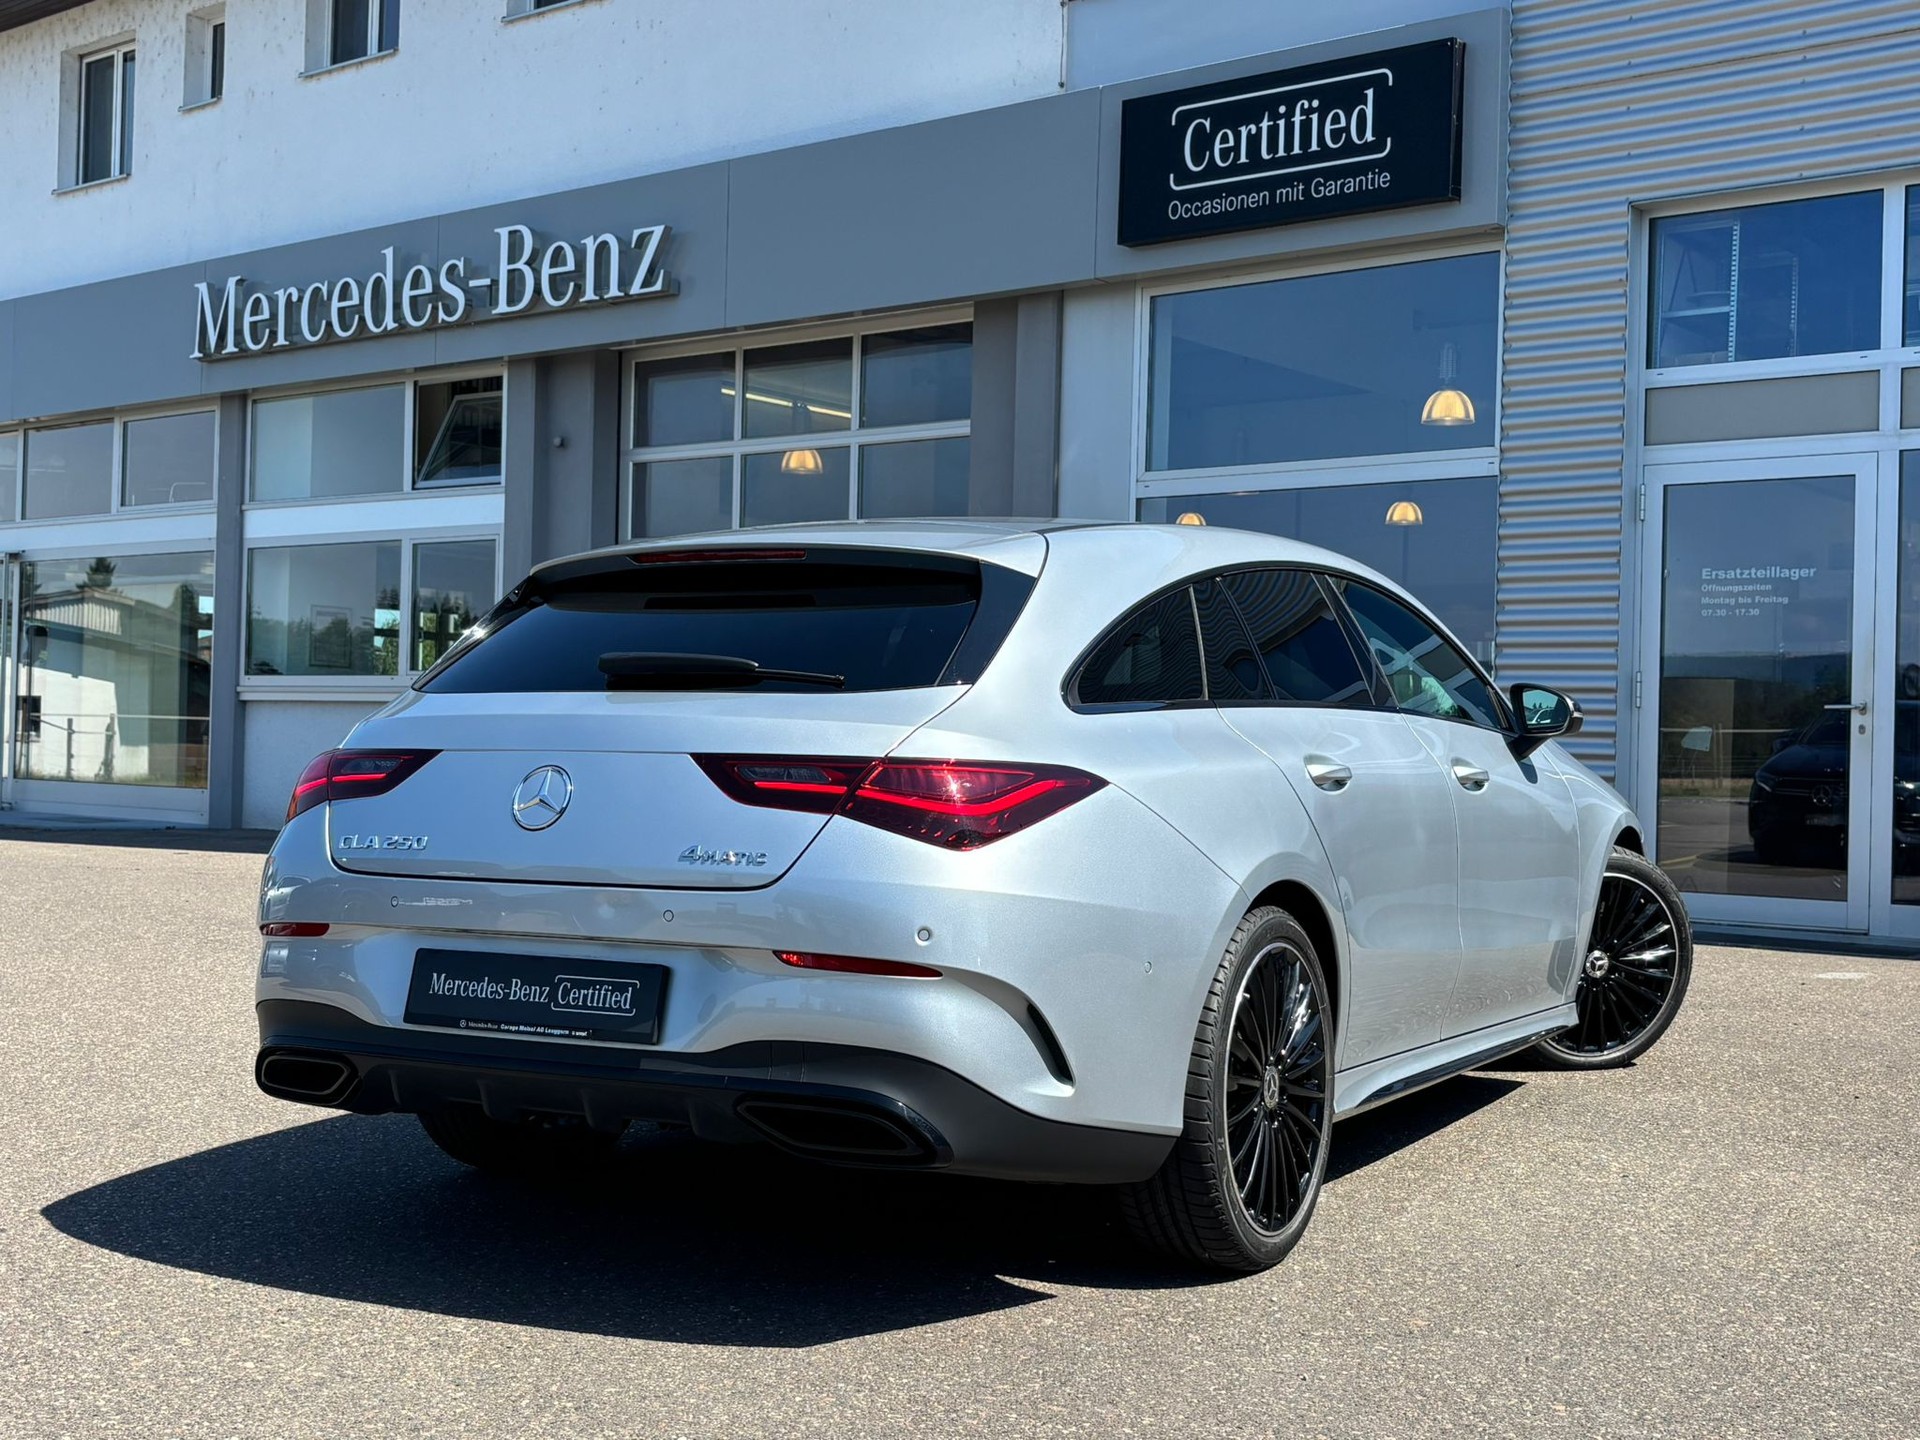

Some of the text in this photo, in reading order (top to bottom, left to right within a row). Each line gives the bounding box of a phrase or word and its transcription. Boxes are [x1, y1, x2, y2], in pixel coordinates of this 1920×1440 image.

[1183, 87, 1376, 173] Certified
[1168, 168, 1391, 220] Occasionen mit Garantie
[189, 224, 669, 360] Mercedes-Benz
[1701, 566, 1817, 581] Ersatzteillager
[1701, 595, 1789, 606] Montag bis Freitag
[1701, 608, 1727, 617] 07.30
[1735, 608, 1760, 617] 17.30
[339, 834, 428, 851] CLA 250
[677, 845, 768, 867] 4MATIC
[428, 972, 632, 1009] Mercedes-Benz Certified
